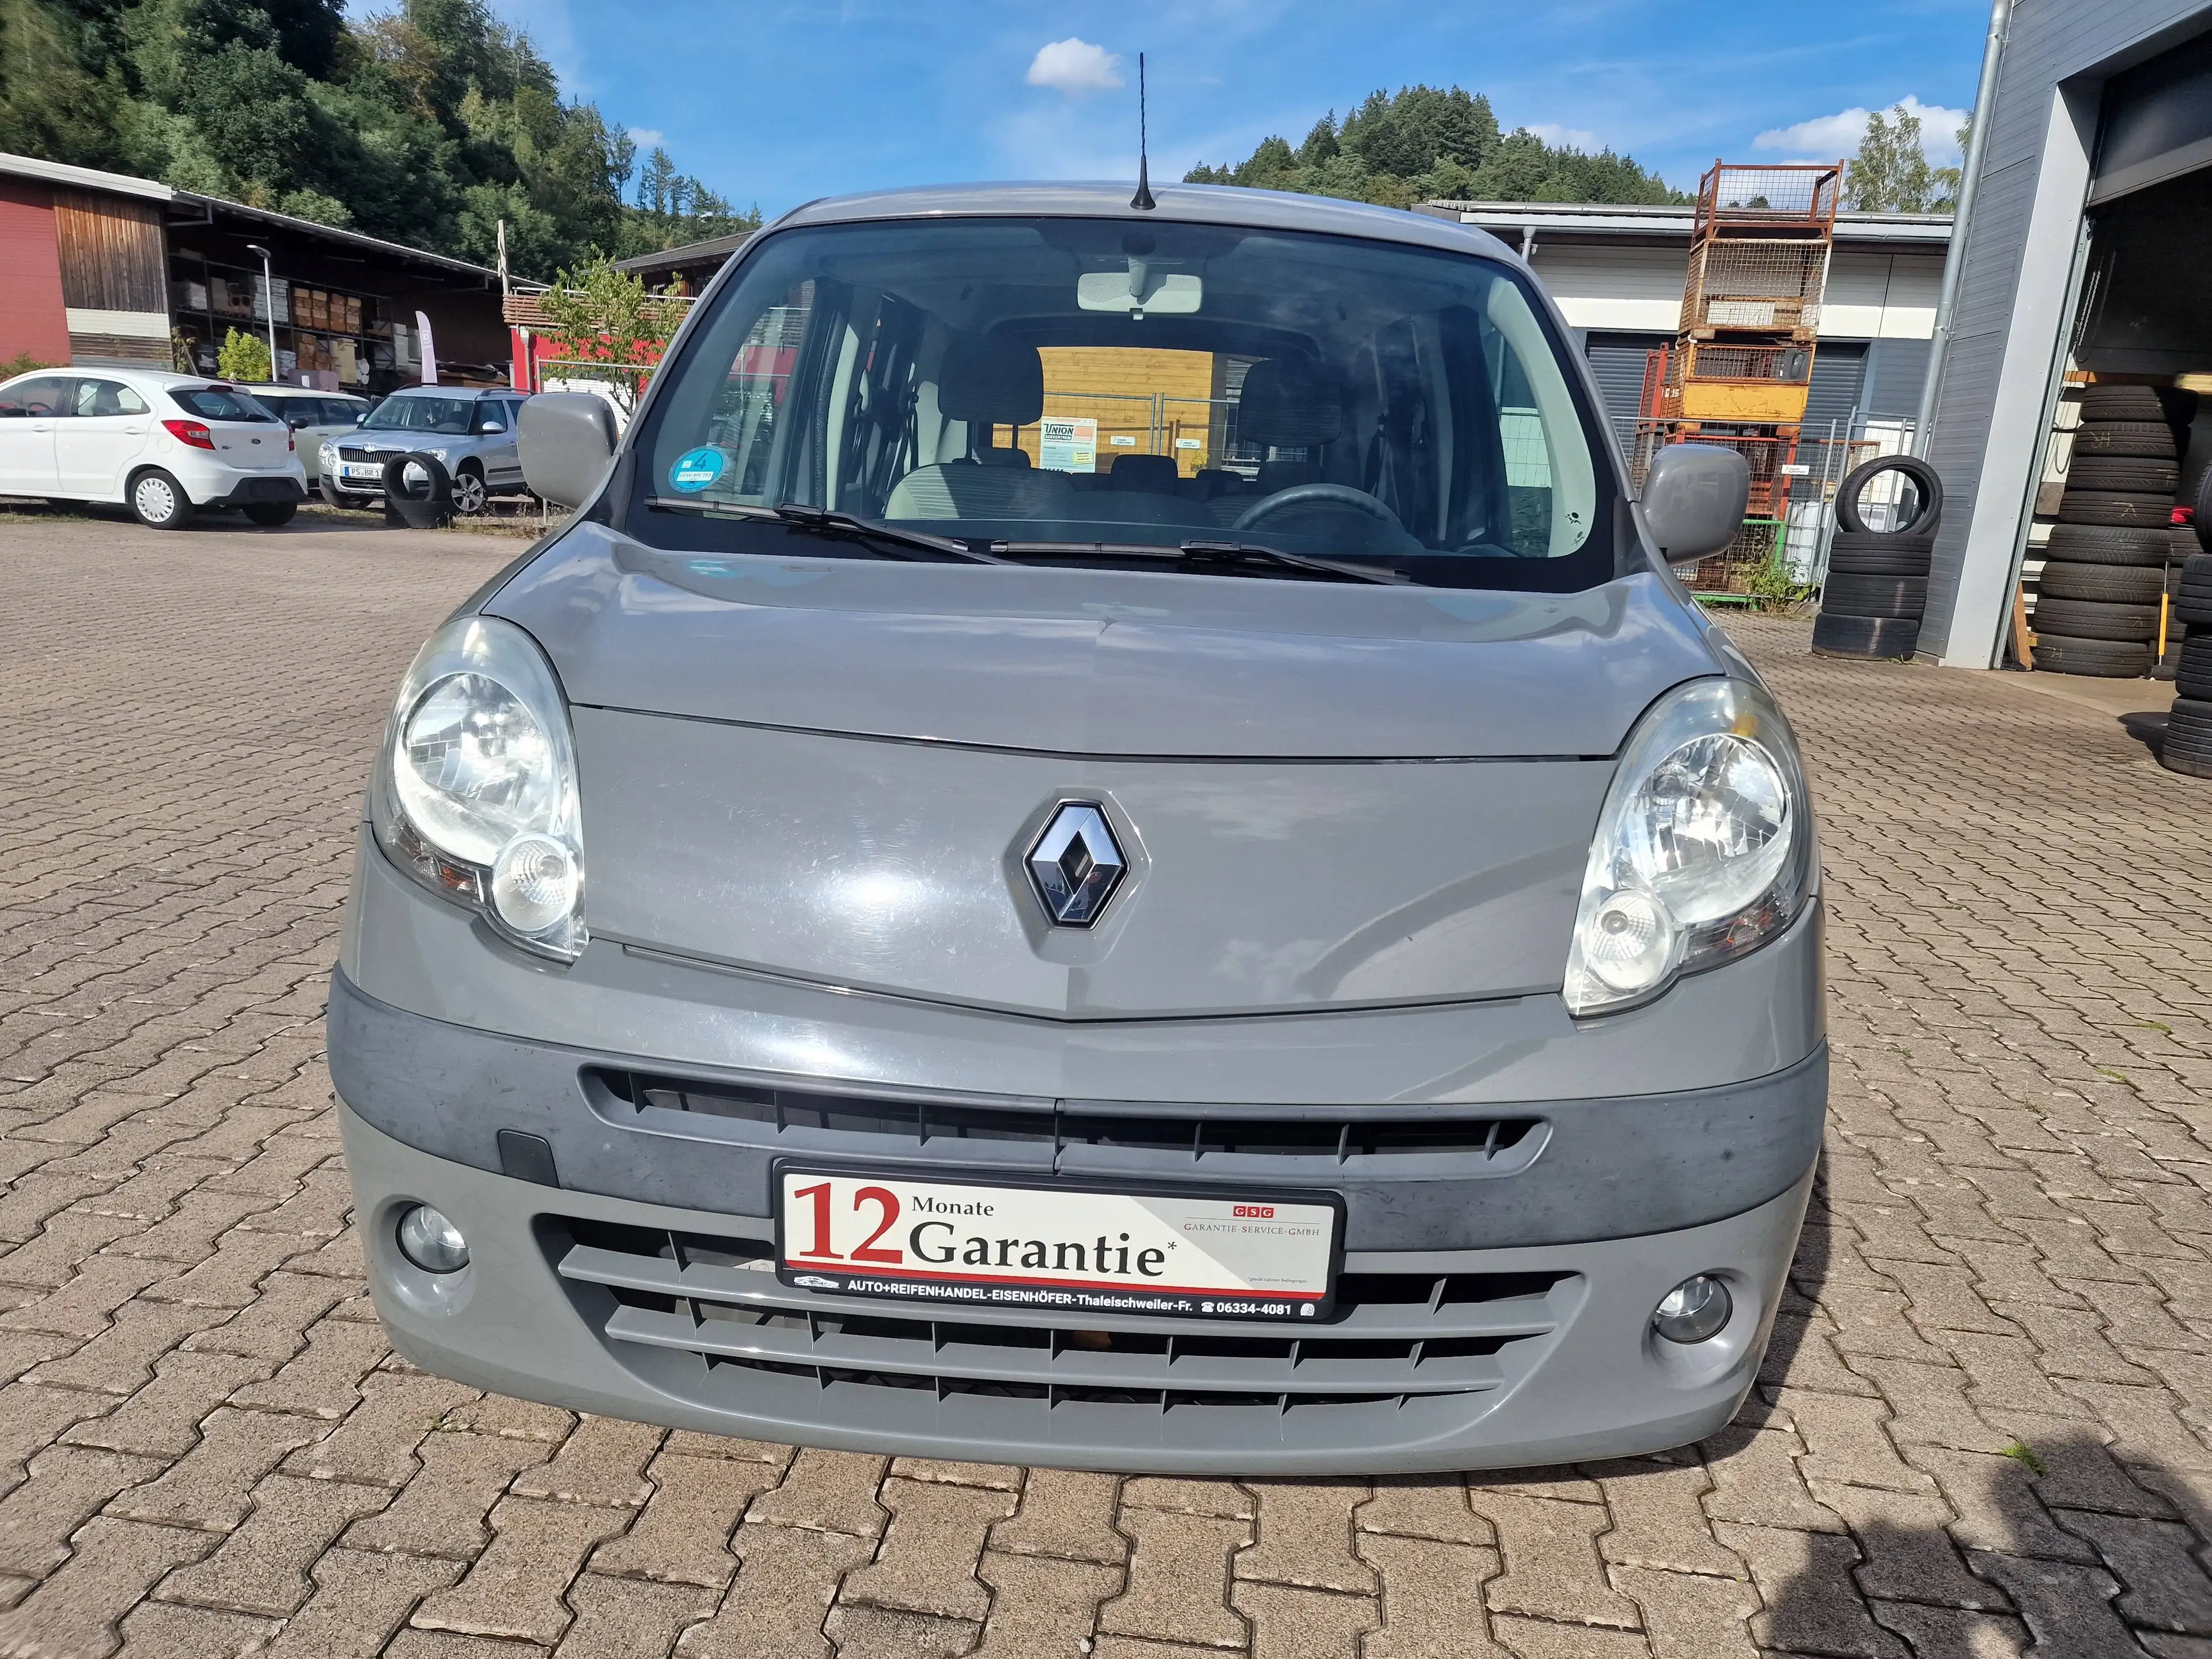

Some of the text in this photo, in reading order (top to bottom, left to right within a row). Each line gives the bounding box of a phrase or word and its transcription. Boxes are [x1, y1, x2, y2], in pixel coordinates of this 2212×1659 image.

[1043, 423, 1074, 435] UNION
[692, 453, 708, 469] 4
[911, 1196, 994, 1216] Monate
[1234, 1206, 1273, 1218] GSG
[794, 1182, 903, 1264] 12
[847, 1279, 1291, 1315] AUTO+REIFENHANDEL-EISENHÖFER-Thaleischweiler-Fr. 06334-4081
